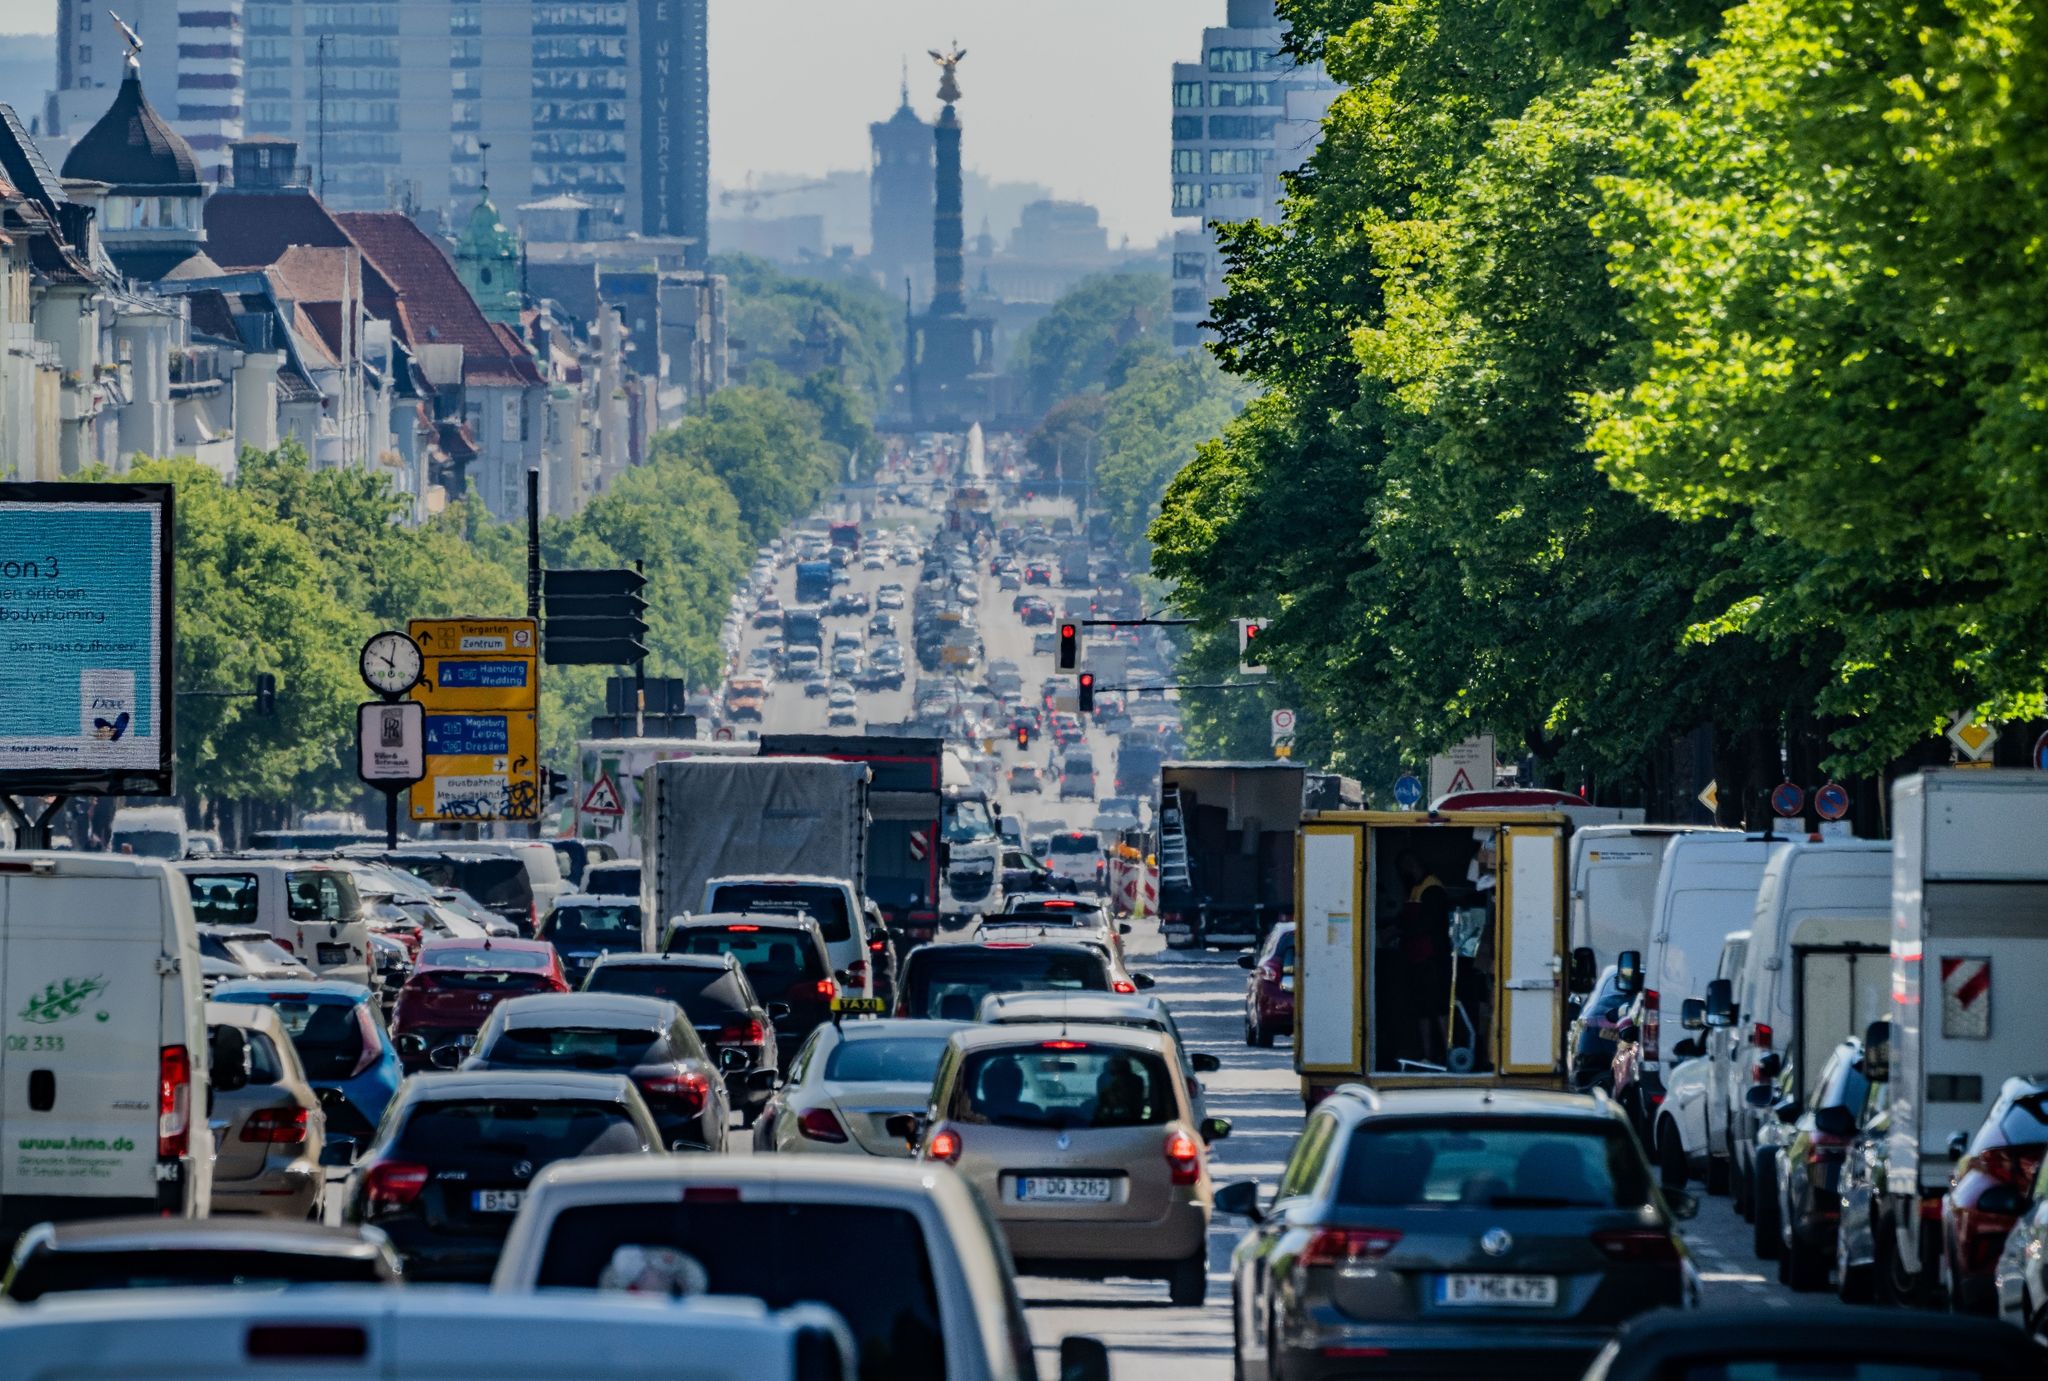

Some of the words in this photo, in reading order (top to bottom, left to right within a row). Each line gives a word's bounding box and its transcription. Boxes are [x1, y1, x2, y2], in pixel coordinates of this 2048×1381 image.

[0, 561, 38, 578] on
[44, 556, 59, 578] 3
[460, 625, 510, 635] Tiergarten
[463, 639, 503, 649] Zentrum
[480, 664, 526, 675] Hamburg
[481, 676, 523, 686] Wedding
[465, 718, 506, 728] Magdeburg
[472, 730, 507, 740] Leipzig
[465, 741, 506, 751] Dresden
[842, 1000, 876, 1009] TAXI
